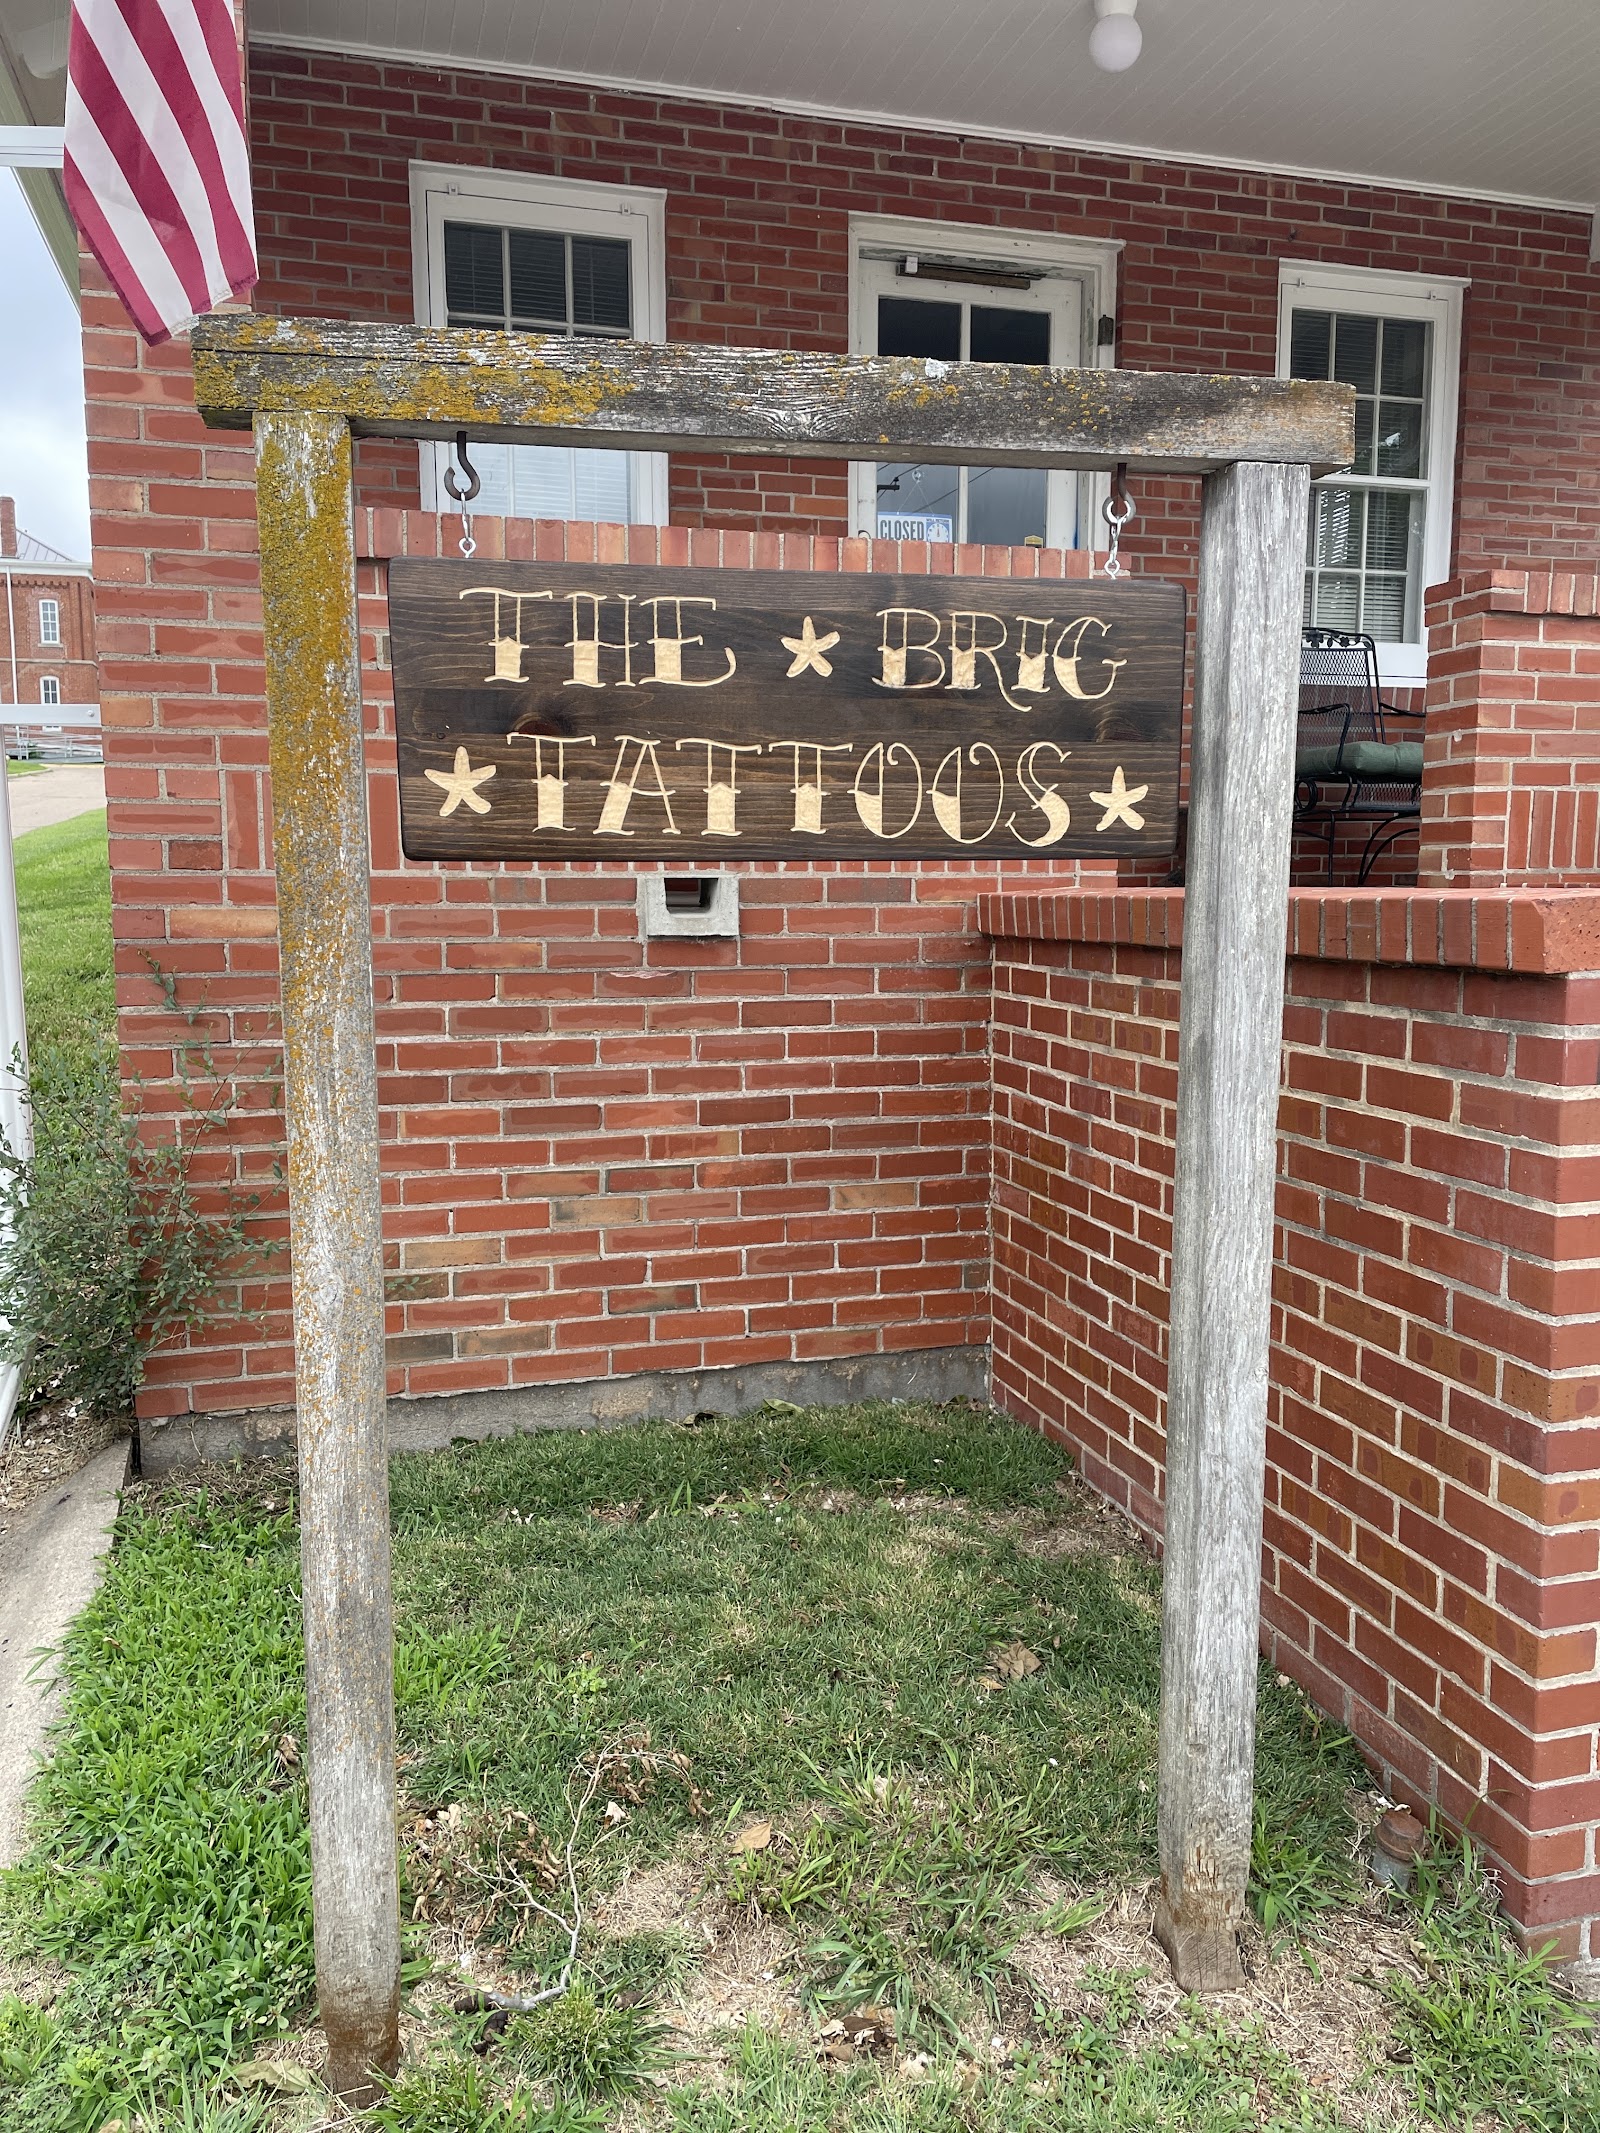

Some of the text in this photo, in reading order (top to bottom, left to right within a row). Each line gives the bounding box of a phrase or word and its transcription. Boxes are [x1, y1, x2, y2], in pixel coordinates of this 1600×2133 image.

[880, 519, 925, 541] CLOSED
[458, 586, 1127, 712] THE BRIG
[506, 731, 1074, 848] TATTOOS
